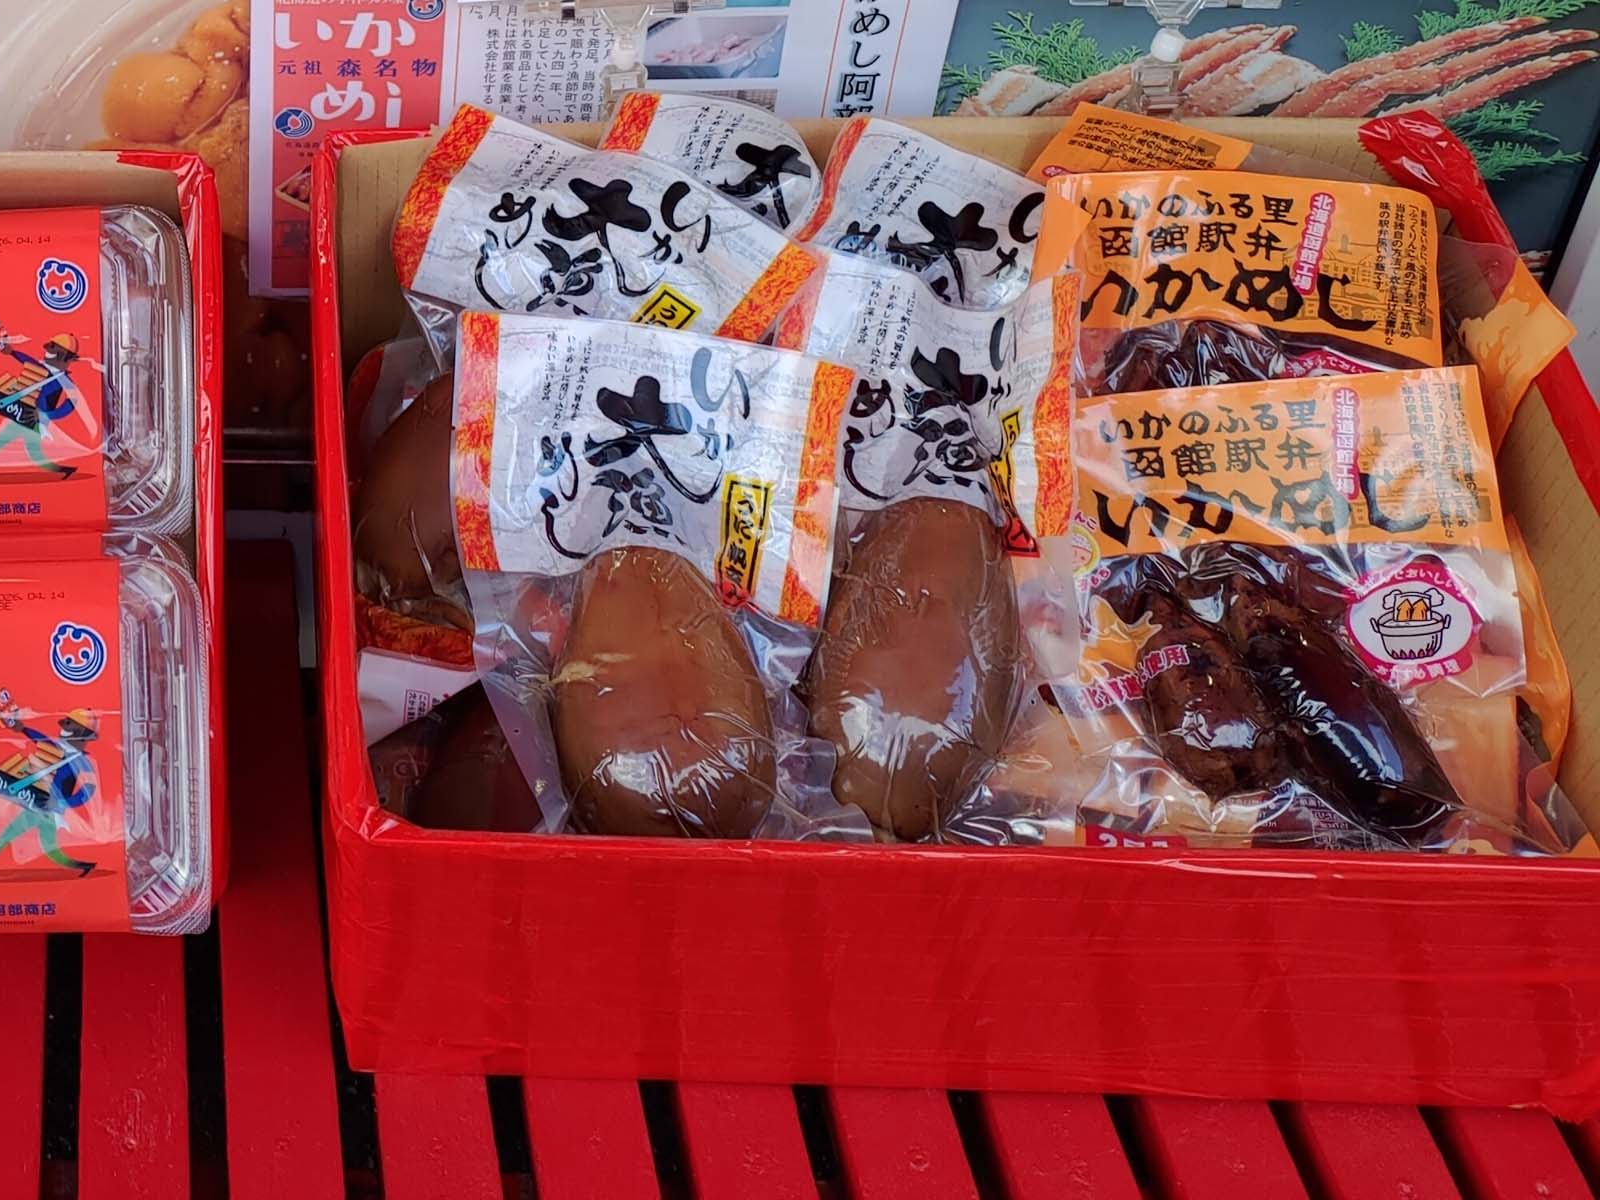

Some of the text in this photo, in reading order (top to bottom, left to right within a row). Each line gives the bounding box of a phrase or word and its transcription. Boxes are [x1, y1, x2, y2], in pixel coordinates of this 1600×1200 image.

[274, 11, 416, 58] いか
[1081, 191, 1299, 228] いかのふる里
[1099, 219, 1289, 264] 函館駅弁
[1098, 399, 1328, 446] いかのふる里
[1334, 388, 1359, 498] 北海道函館工場
[1123, 433, 1328, 483] 函館駅弁
[1092, 468, 1432, 549] いかめし
